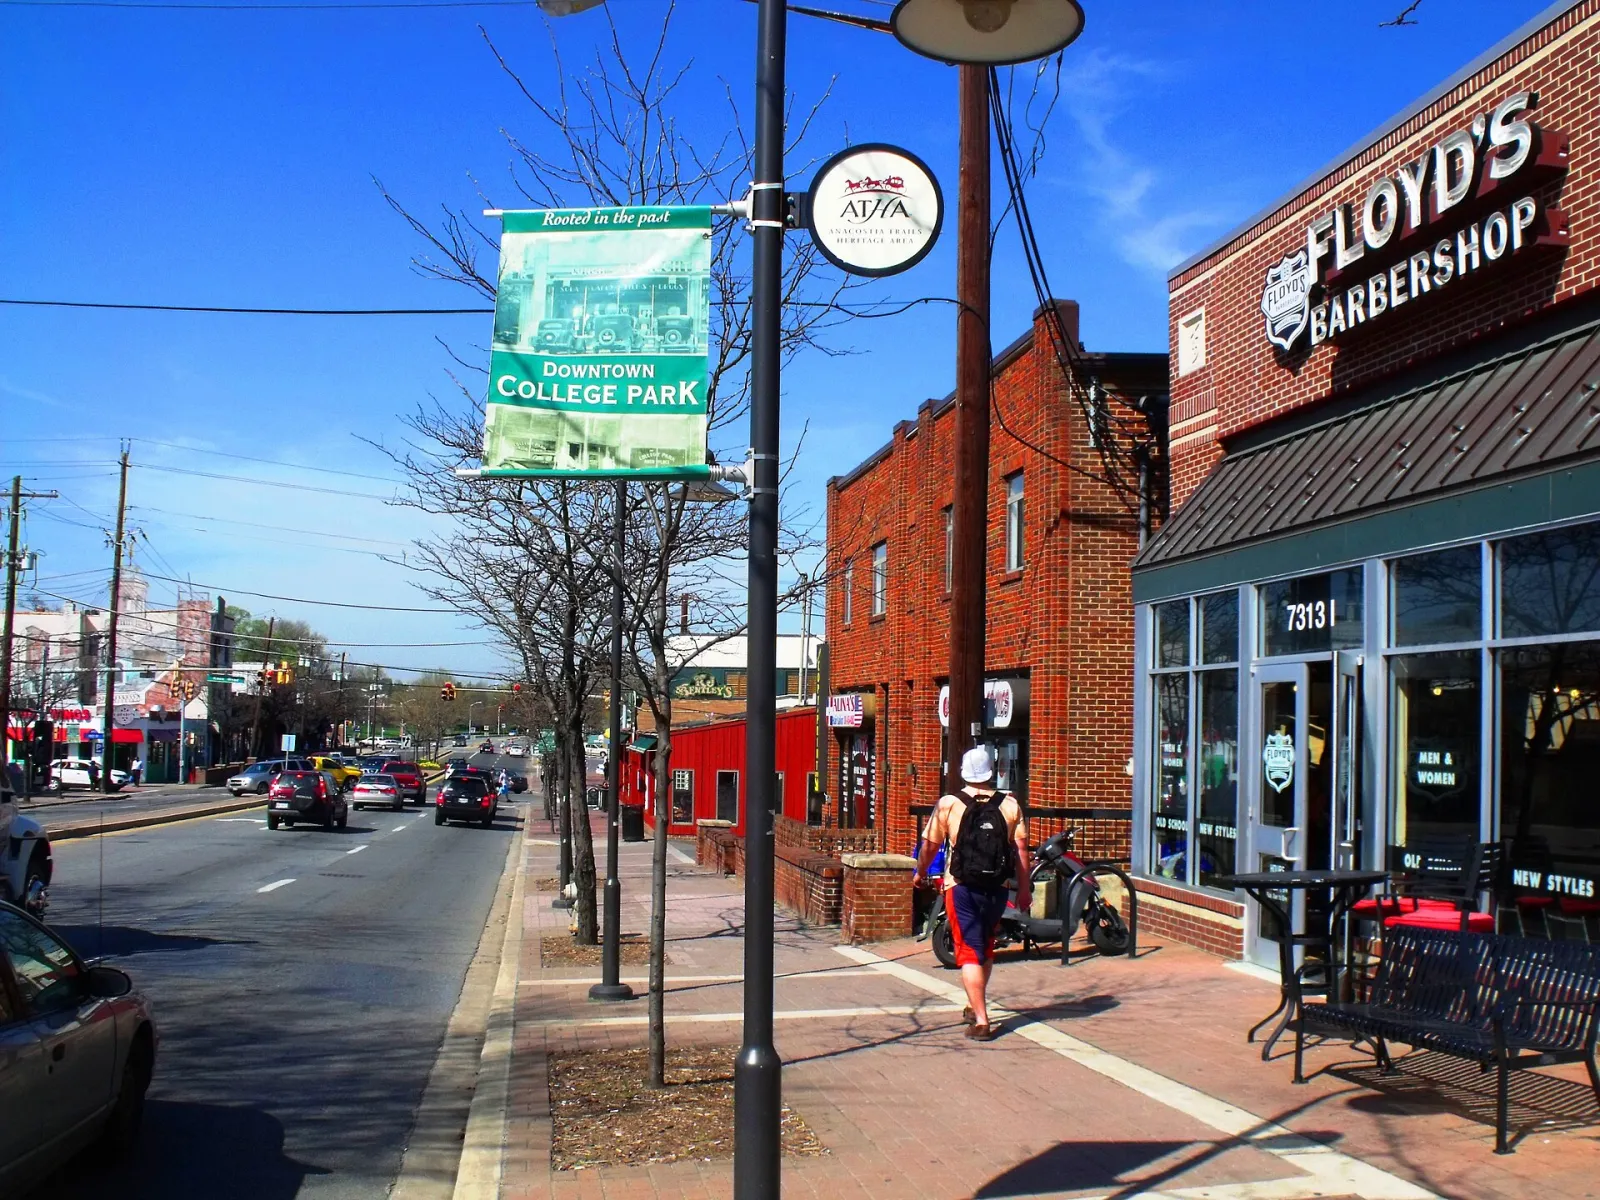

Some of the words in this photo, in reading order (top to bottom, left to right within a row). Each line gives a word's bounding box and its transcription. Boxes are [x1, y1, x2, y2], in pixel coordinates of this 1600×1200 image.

[1306, 91, 1539, 286] FLOYD'S
[541, 209, 592, 227] Rooted
[593, 209, 609, 225] in
[612, 208, 633, 225] the
[637, 209, 671, 228] past
[839, 196, 910, 225] ATHA
[828, 227, 885, 235] ANACOSTIA
[889, 227, 923, 235] TRAILS
[836, 236, 886, 244] HERITAGE
[889, 236, 915, 245] AREA
[1309, 196, 1538, 346] BARBERSHOP
[1267, 273, 1306, 312] FLOYD'S
[543, 361, 655, 378] DOWNTOWN
[497, 375, 618, 405] COLLEGE
[627, 380, 699, 405] PARK
[1286, 600, 1326, 631] 7313
[1164, 743, 1176, 754] MEN
[1177, 743, 1182, 754] &
[1163, 757, 1184, 768] WOMEN
[1419, 752, 1440, 765] MEN
[1444, 752, 1452, 765] &
[1418, 771, 1455, 786] WOMEN
[1156, 816, 1167, 828] OLD
[1199, 824, 1214, 836] NEW
[1215, 825, 1237, 839] STYLES
[1513, 869, 1542, 889] NEW
[1547, 874, 1595, 898] STYLES
